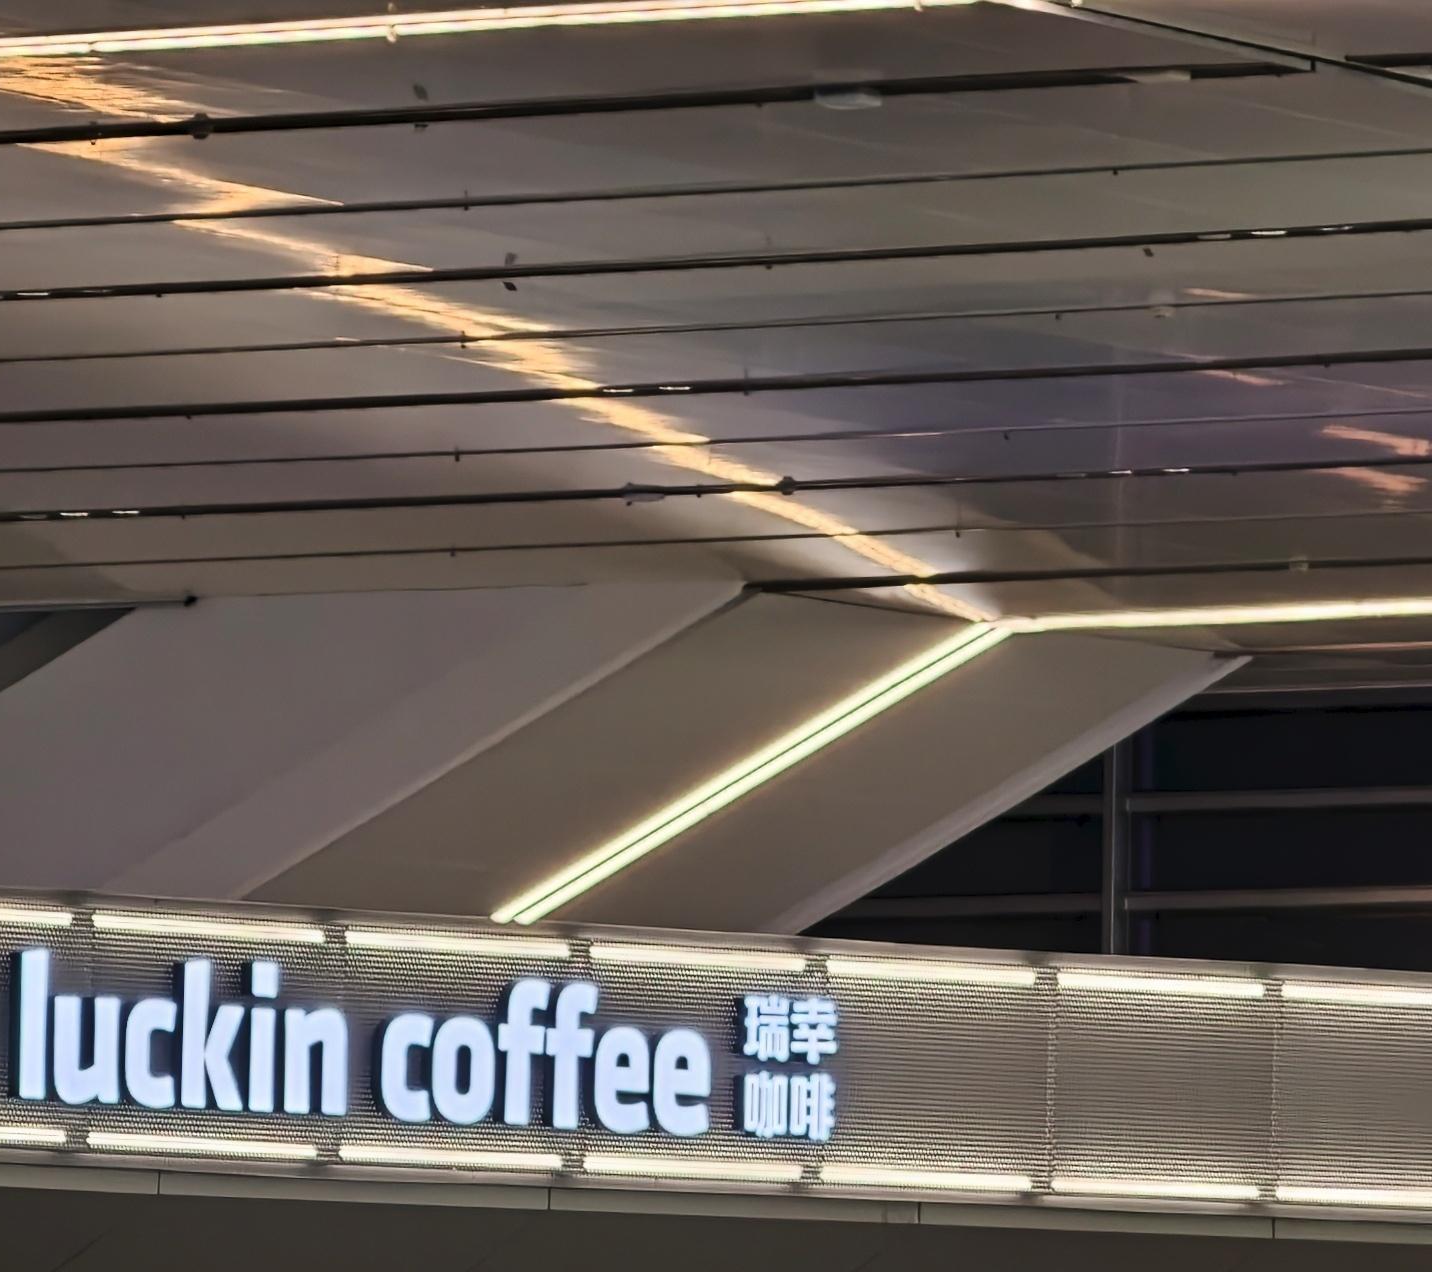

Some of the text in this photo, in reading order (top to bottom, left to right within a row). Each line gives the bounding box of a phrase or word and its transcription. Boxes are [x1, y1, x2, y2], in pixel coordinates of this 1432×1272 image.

[14, 946, 712, 1138] luckin coffee
[742, 994, 838, 1065] 瑞幸
[742, 1070, 837, 1142] 咖啡
